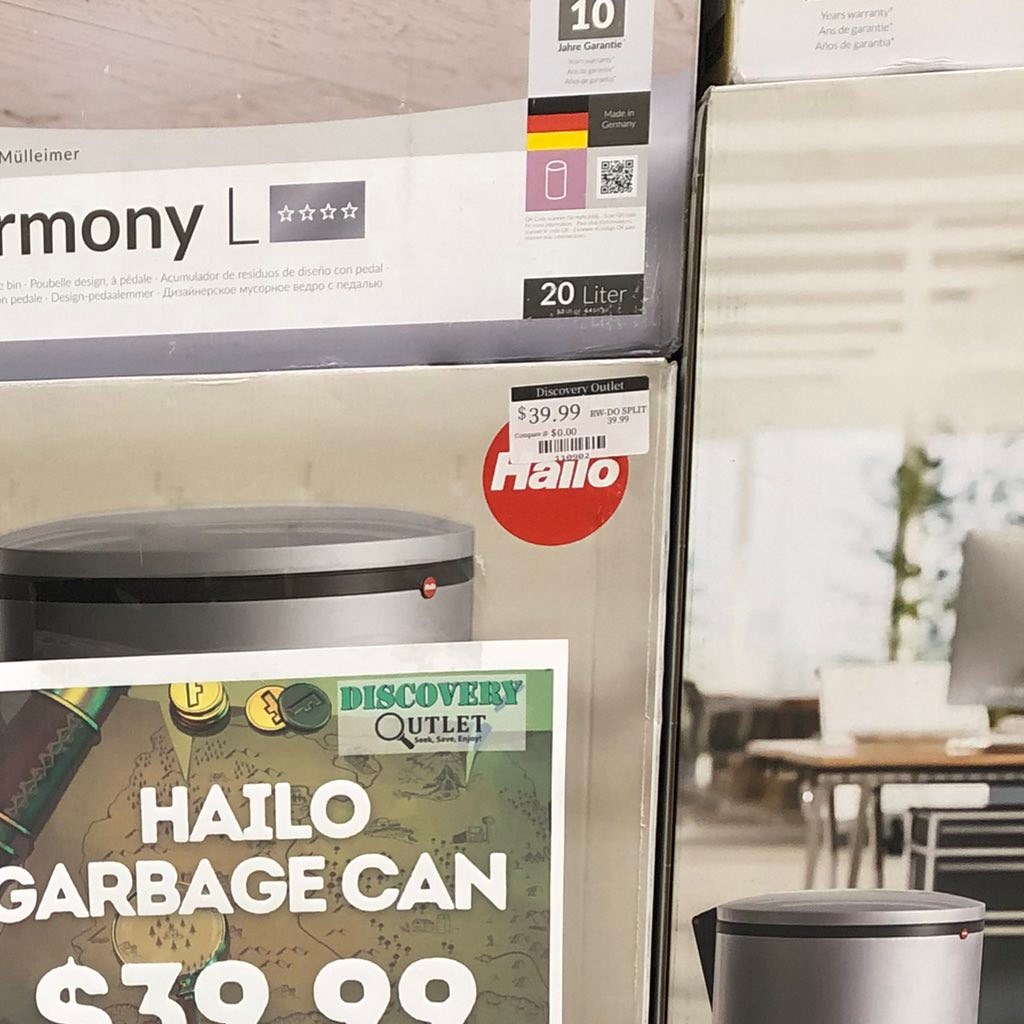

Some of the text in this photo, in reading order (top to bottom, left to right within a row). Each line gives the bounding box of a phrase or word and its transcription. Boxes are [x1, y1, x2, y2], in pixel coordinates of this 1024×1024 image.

[571, 0, 615, 31] 10
[558, 42, 581, 52] Jahre
[604, 108, 635, 118] Made in
[601, 119, 636, 129] Germany
[228, 187, 260, 246] L
[7, 279, 21, 290] bin
[30, 277, 72, 289] Poubelle
[160, 271, 220, 283] Acumulador
[223, 270, 235, 281] de
[238, 268, 279, 280] residuos
[282, 267, 295, 278] de
[334, 266, 352, 276] con
[356, 263, 383, 277] pedal
[11, 292, 42, 305] pedale
[540, 281, 627, 306] 20 Liter
[536, 381, 625, 398] Discovery Outlet
[517, 403, 581, 425] $39.99
[590, 405, 647, 418] RW-DO SPLIT
[607, 415, 629, 425] 39.99
[551, 428, 577, 437] $0.00
[491, 452, 621, 491] Hailo
[340, 680, 523, 711] DISCOVERY
[414, 735, 482, 745] Seek, Save, Enjoy!
[140, 779, 372, 845] HAILO
[341, 852, 508, 913] CAN
